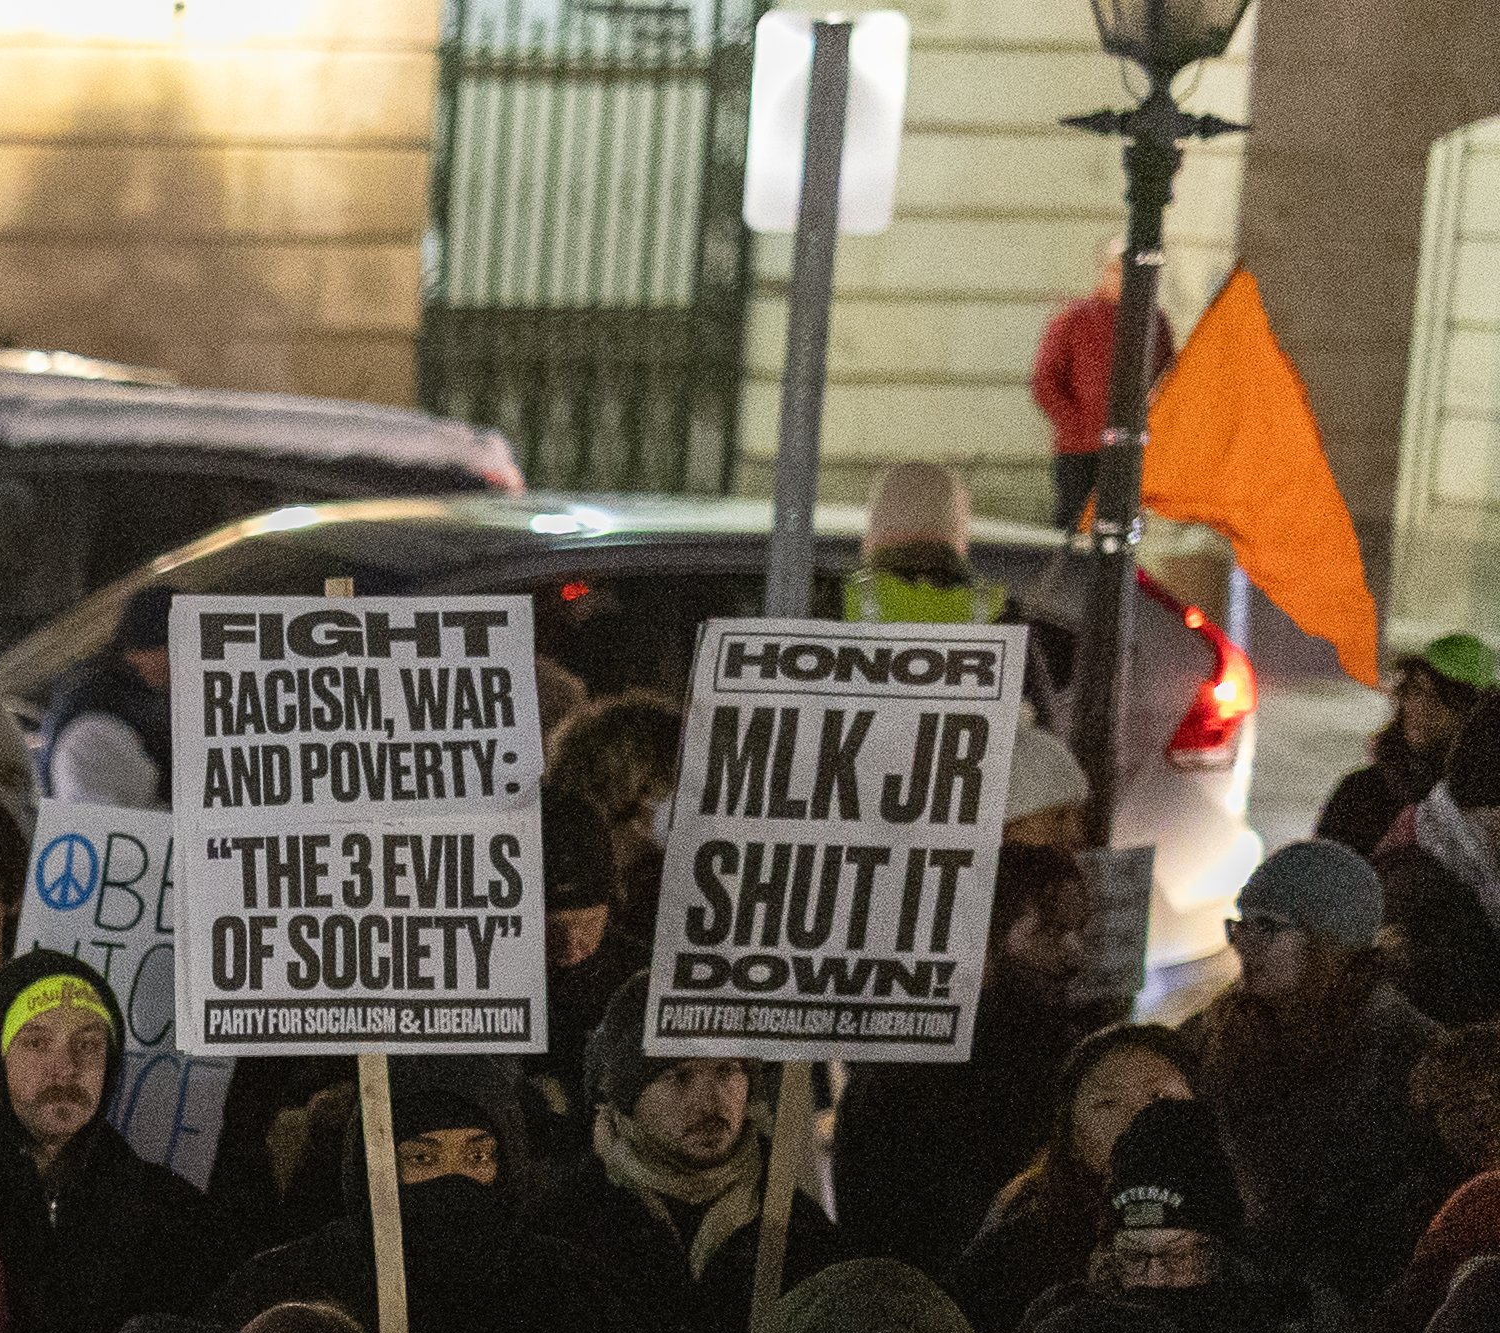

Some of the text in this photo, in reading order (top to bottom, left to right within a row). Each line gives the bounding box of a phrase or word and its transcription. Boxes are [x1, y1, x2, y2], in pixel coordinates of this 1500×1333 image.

[201, 610, 508, 660] FIGHT
[724, 643, 997, 687] HONOR
[202, 666, 515, 738] RACISM, WAR
[203, 739, 521, 808] AND POVERTY:
[700, 706, 989, 824] MLK JR
[342, 833, 373, 909] 3
[382, 833, 524, 910] EVILS
[685, 840, 890, 950] SHUT
[895, 847, 973, 954] IT
[211, 915, 277, 991] OF
[672, 952, 956, 998] DOWN!
[209, 1007, 525, 1036] PARTY FOR SOCIALISM & LIBERATION
[660, 1005, 954, 1038] PARTY FOR SOCIALISM & LIBERATION
